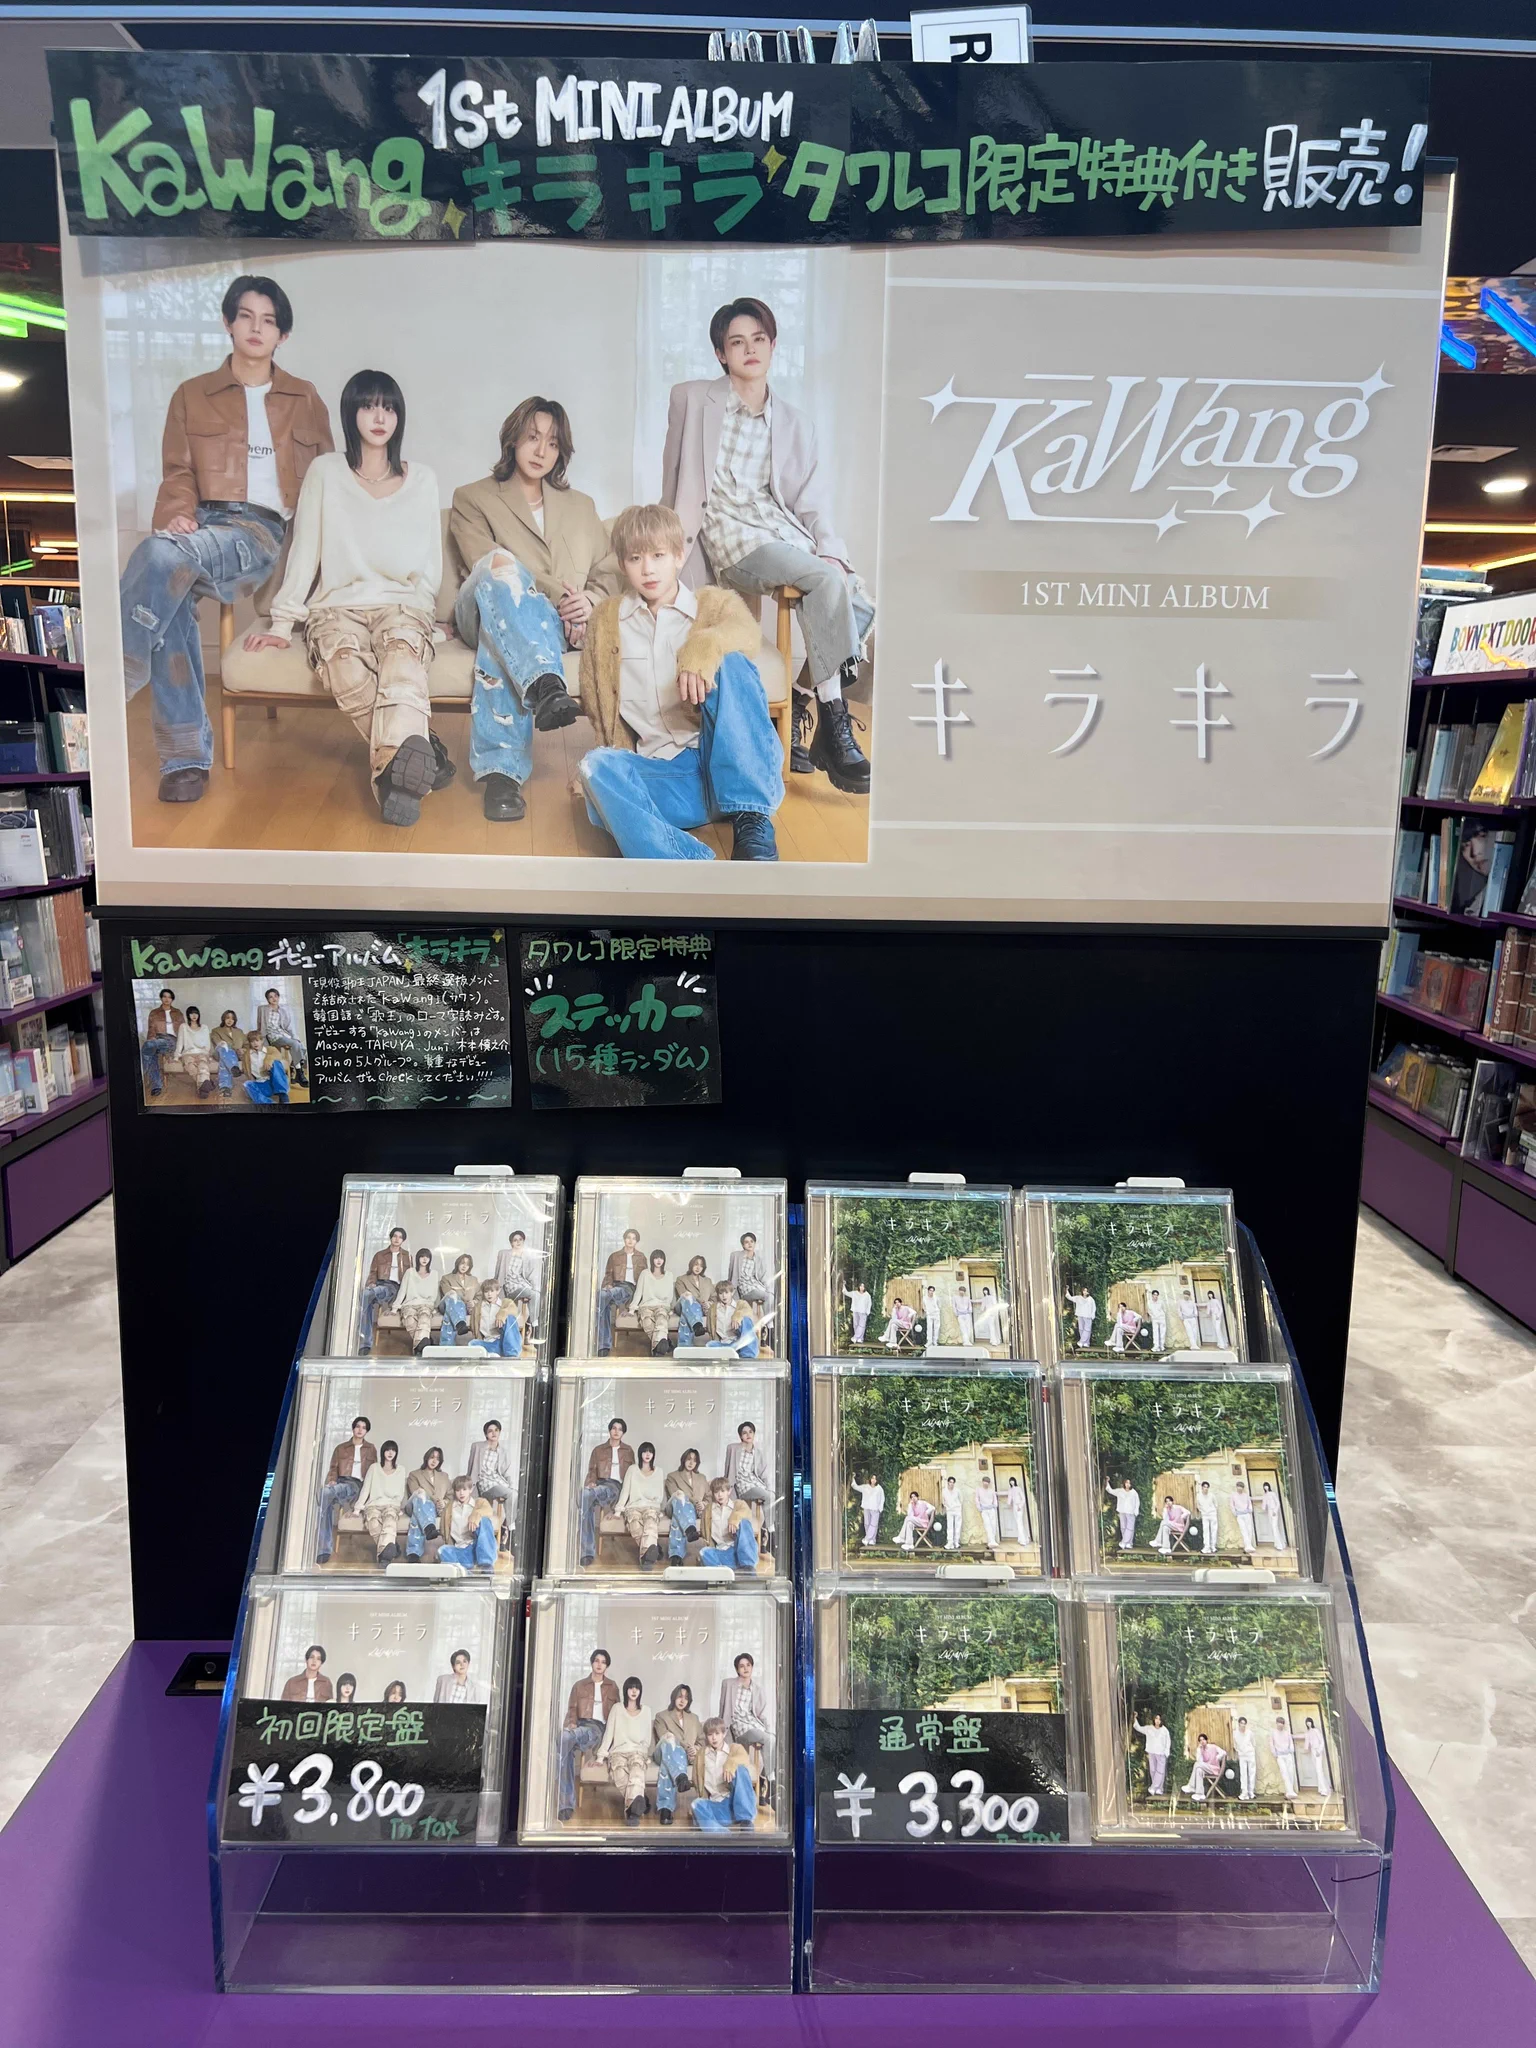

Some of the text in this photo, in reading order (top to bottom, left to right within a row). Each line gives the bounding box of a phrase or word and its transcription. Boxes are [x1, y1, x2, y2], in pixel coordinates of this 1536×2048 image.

[536, 74, 662, 147] MINI
[660, 85, 793, 146] ALBUM
[69, 97, 433, 237] KaWang
[921, 372, 1374, 524] KaWang
[1021, 581, 1271, 610] 1ST MINI ALBUM
[908, 657, 1364, 759] キラキラ
[528, 934, 712, 967] タワレコ限定特典
[529, 984, 704, 1038] ステッカー
[256, 1706, 429, 1746] 初回限定盤
[879, 1714, 990, 1753] 通常盤
